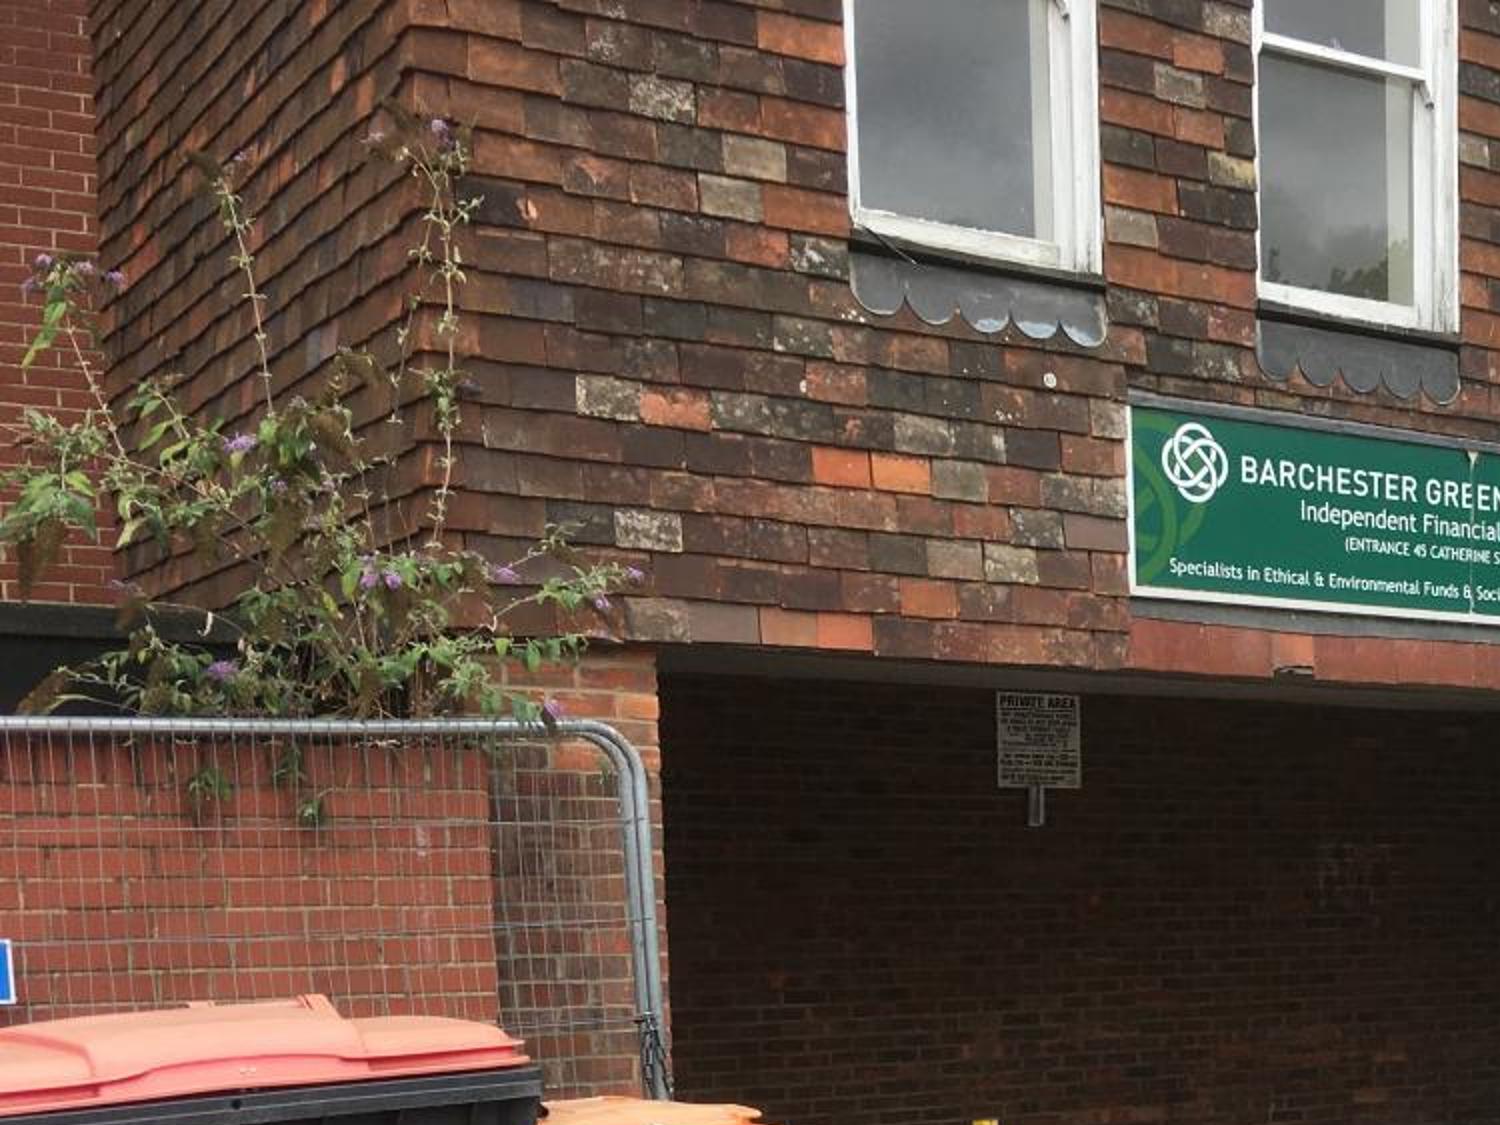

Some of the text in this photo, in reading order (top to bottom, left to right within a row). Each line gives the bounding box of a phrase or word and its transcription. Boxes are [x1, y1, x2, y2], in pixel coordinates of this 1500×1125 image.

[1241, 455, 1417, 503] BARCHESTER
[1301, 499, 1417, 533] Independent
[1423, 513, 1500, 542] Financial
[1345, 537, 1410, 556] (ENTRANCE
[1414, 543, 1426, 557] 45
[1430, 545, 1491, 564] CATHERINE
[1169, 557, 1242, 579] Specialists
[1247, 566, 1260, 581] in
[1264, 567, 1310, 586] Ethical
[1314, 572, 1324, 587] &
[1328, 573, 1420, 595] Environmental
[1424, 581, 1459, 598] Funds
[1463, 584, 1473, 599] &
